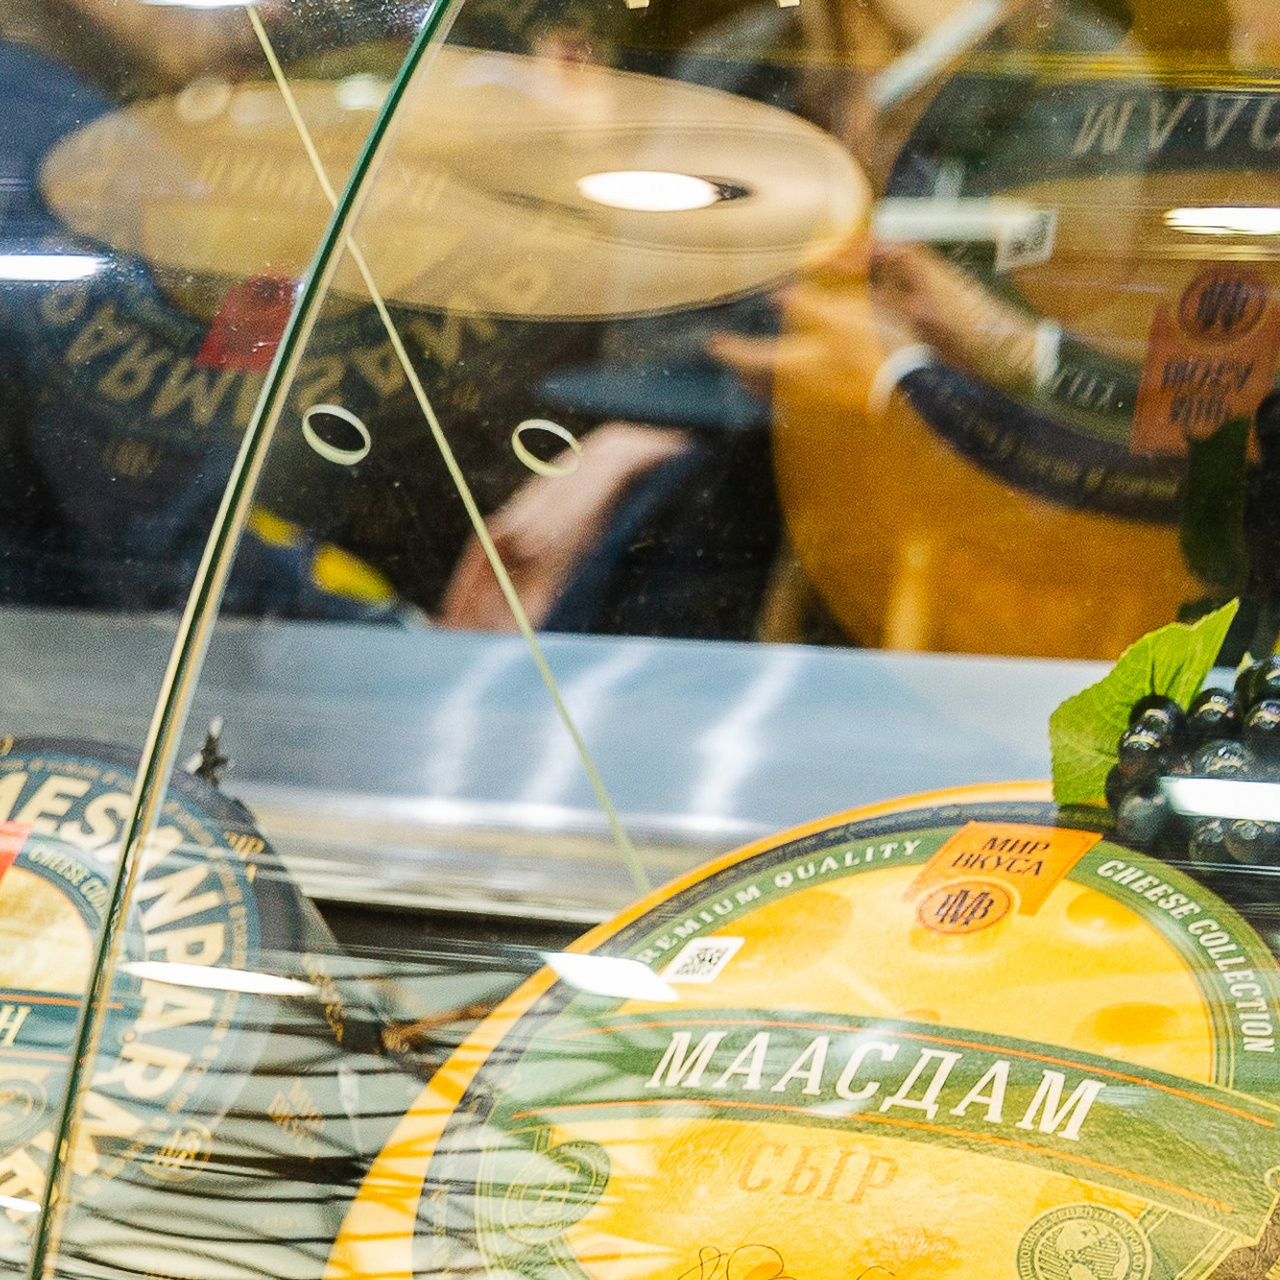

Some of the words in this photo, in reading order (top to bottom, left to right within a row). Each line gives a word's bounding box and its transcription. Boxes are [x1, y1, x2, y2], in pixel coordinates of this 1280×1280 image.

[951, 852, 1047, 877] ВКУСА
[980, 835, 1051, 856] МИР
[639, 885, 761, 967] REMIUM
[774, 837, 922, 890] QUALITY
[1096, 858, 1203, 921] CHEESE
[1187, 917, 1277, 1055] COLLECTION
[644, 1030, 1107, 1142] МААСДАМ
[738, 1140, 902, 1207] СЫР
